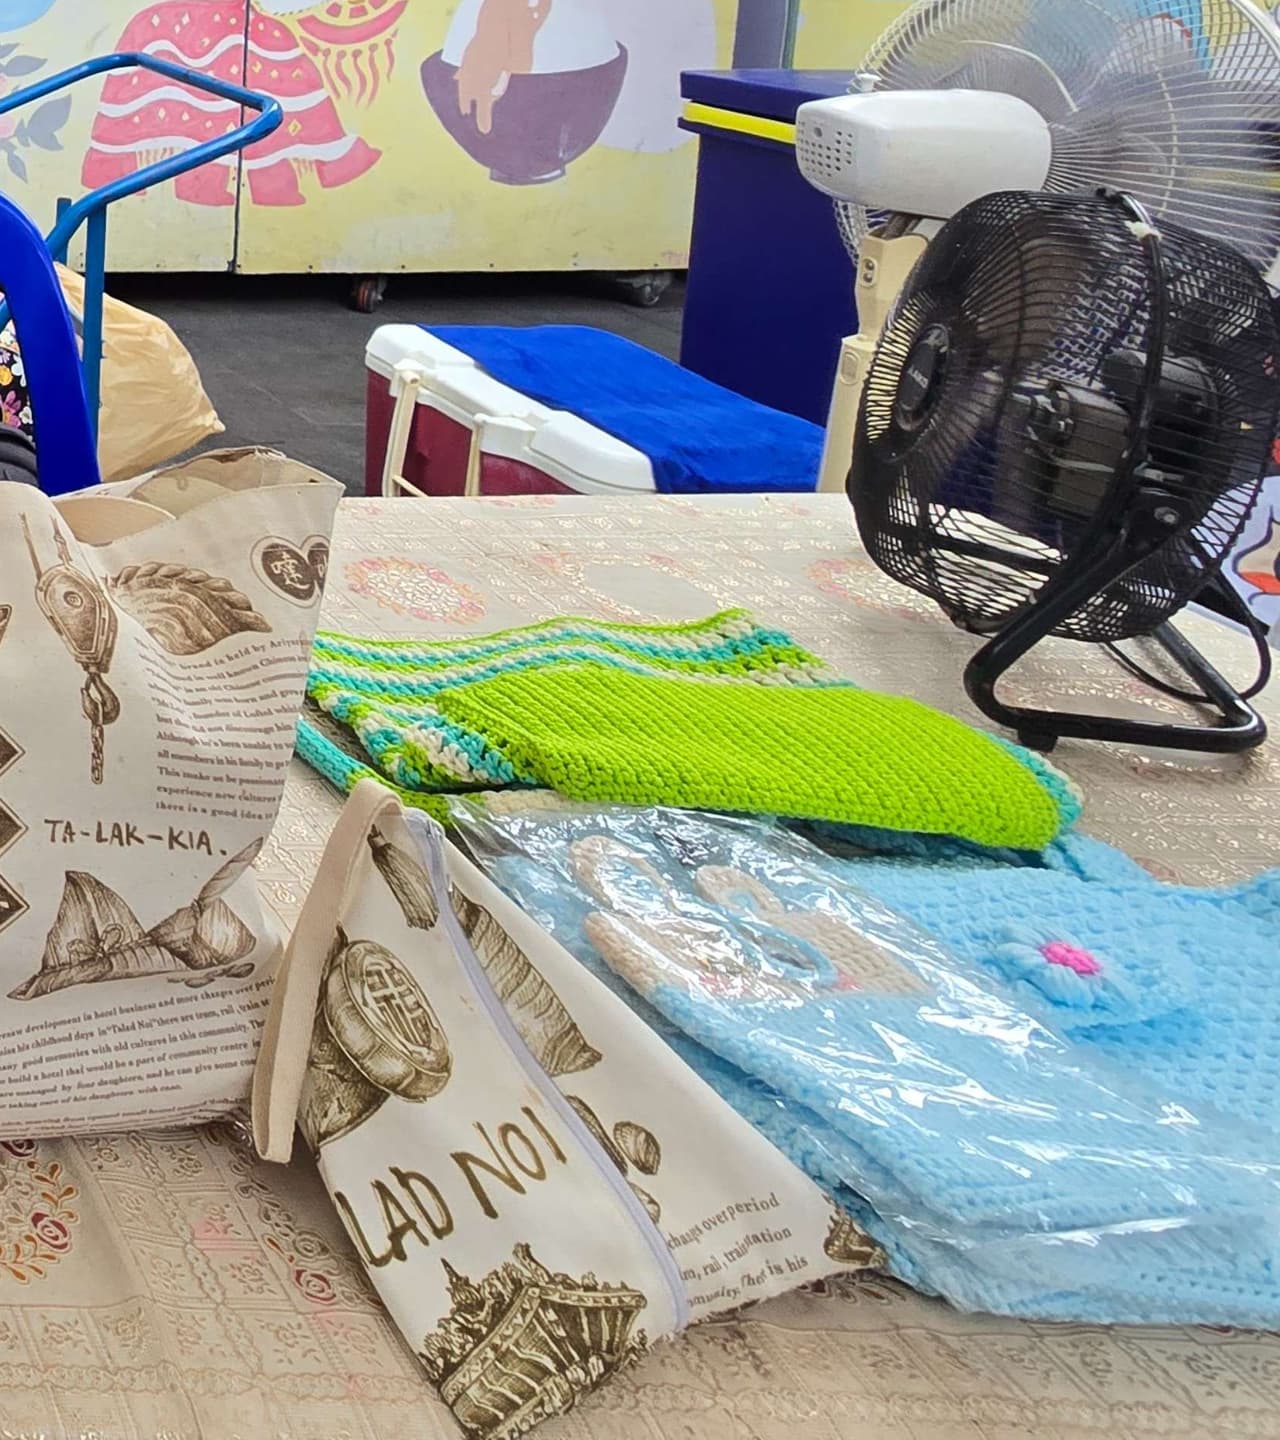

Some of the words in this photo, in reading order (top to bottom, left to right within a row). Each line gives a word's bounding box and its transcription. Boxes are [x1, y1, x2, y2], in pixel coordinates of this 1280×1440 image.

[158, 766, 180, 777] This
[157, 785, 213, 799] experience
[156, 802, 184, 811] there
[241, 809, 263, 820] idea
[25, 1015, 81, 1035] development
[83, 1011, 93, 1021] in
[94, 1006, 118, 1020] hotel
[119, 1002, 156, 1016] business
[158, 996, 175, 1009] and
[176, 995, 199, 1006] more
[16, 1043, 30, 1054] his
[31, 1034, 73, 1050] childhood
[22, 1055, 43, 1069] good
[92, 1043, 111, 1056] with
[113, 1040, 129, 1052] old
[130, 1036, 167, 1051] cultures
[168, 1033, 178, 1044] in
[178, 1029, 195, 1041] this
[41, 1068, 64, 1081] hotel
[86, 1060, 113, 1074] would
[115, 1057, 126, 1069] be
[135, 1054, 156, 1068] part
[157, 1052, 167, 1064] of
[168, 1044, 218, 1061] community
[334, 1165, 454, 1268] LAD
[450, 1105, 566, 1221] NOI
[727, 1191, 781, 1221] period
[766, 1258, 784, 1276] is
[784, 1255, 809, 1273] his
